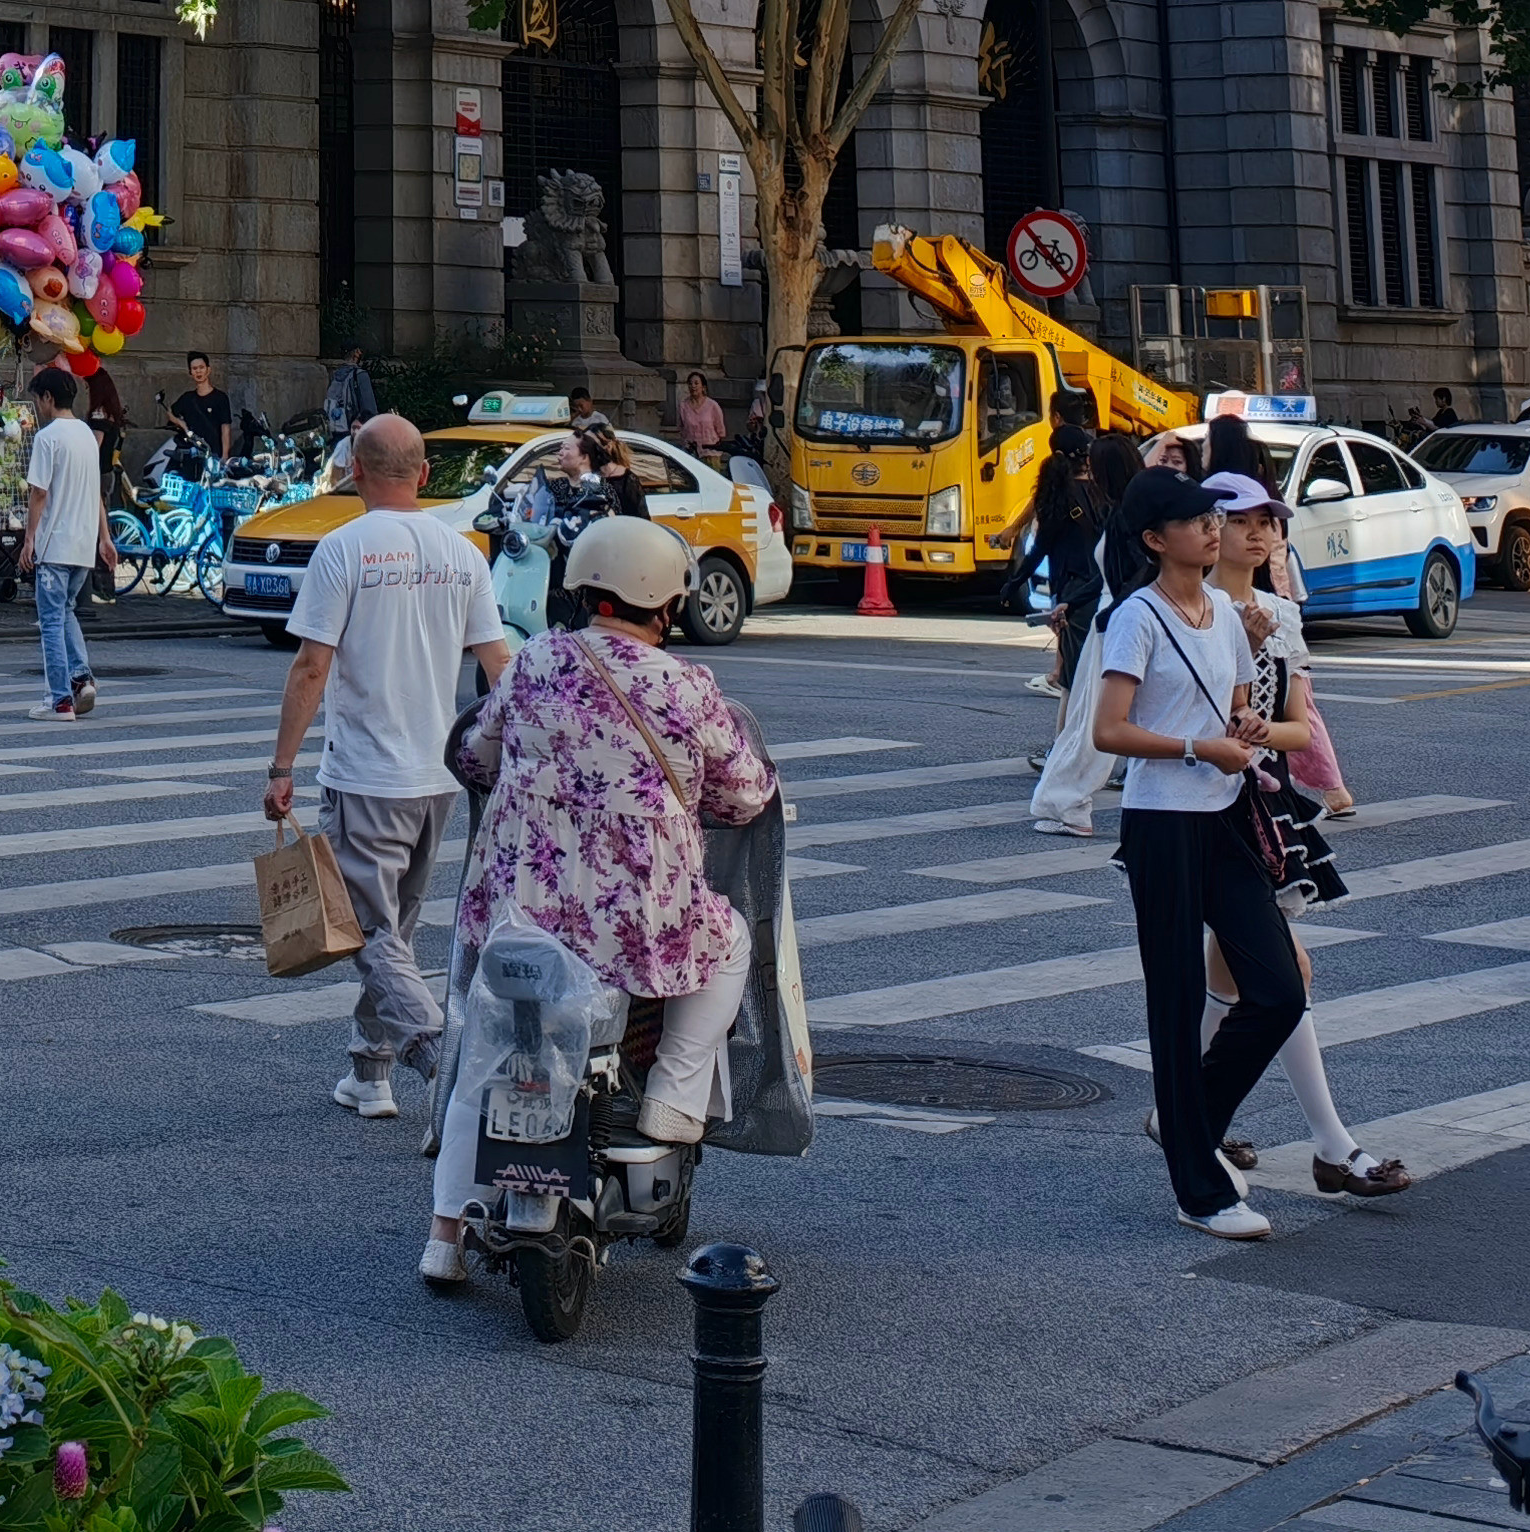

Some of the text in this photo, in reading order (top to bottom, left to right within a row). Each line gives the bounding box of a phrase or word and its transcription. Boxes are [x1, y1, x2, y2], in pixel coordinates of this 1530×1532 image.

[1257, 398, 1296, 412] 明天
[362, 552, 415, 565] MIAMI
[361, 563, 472, 591] Dolphins
